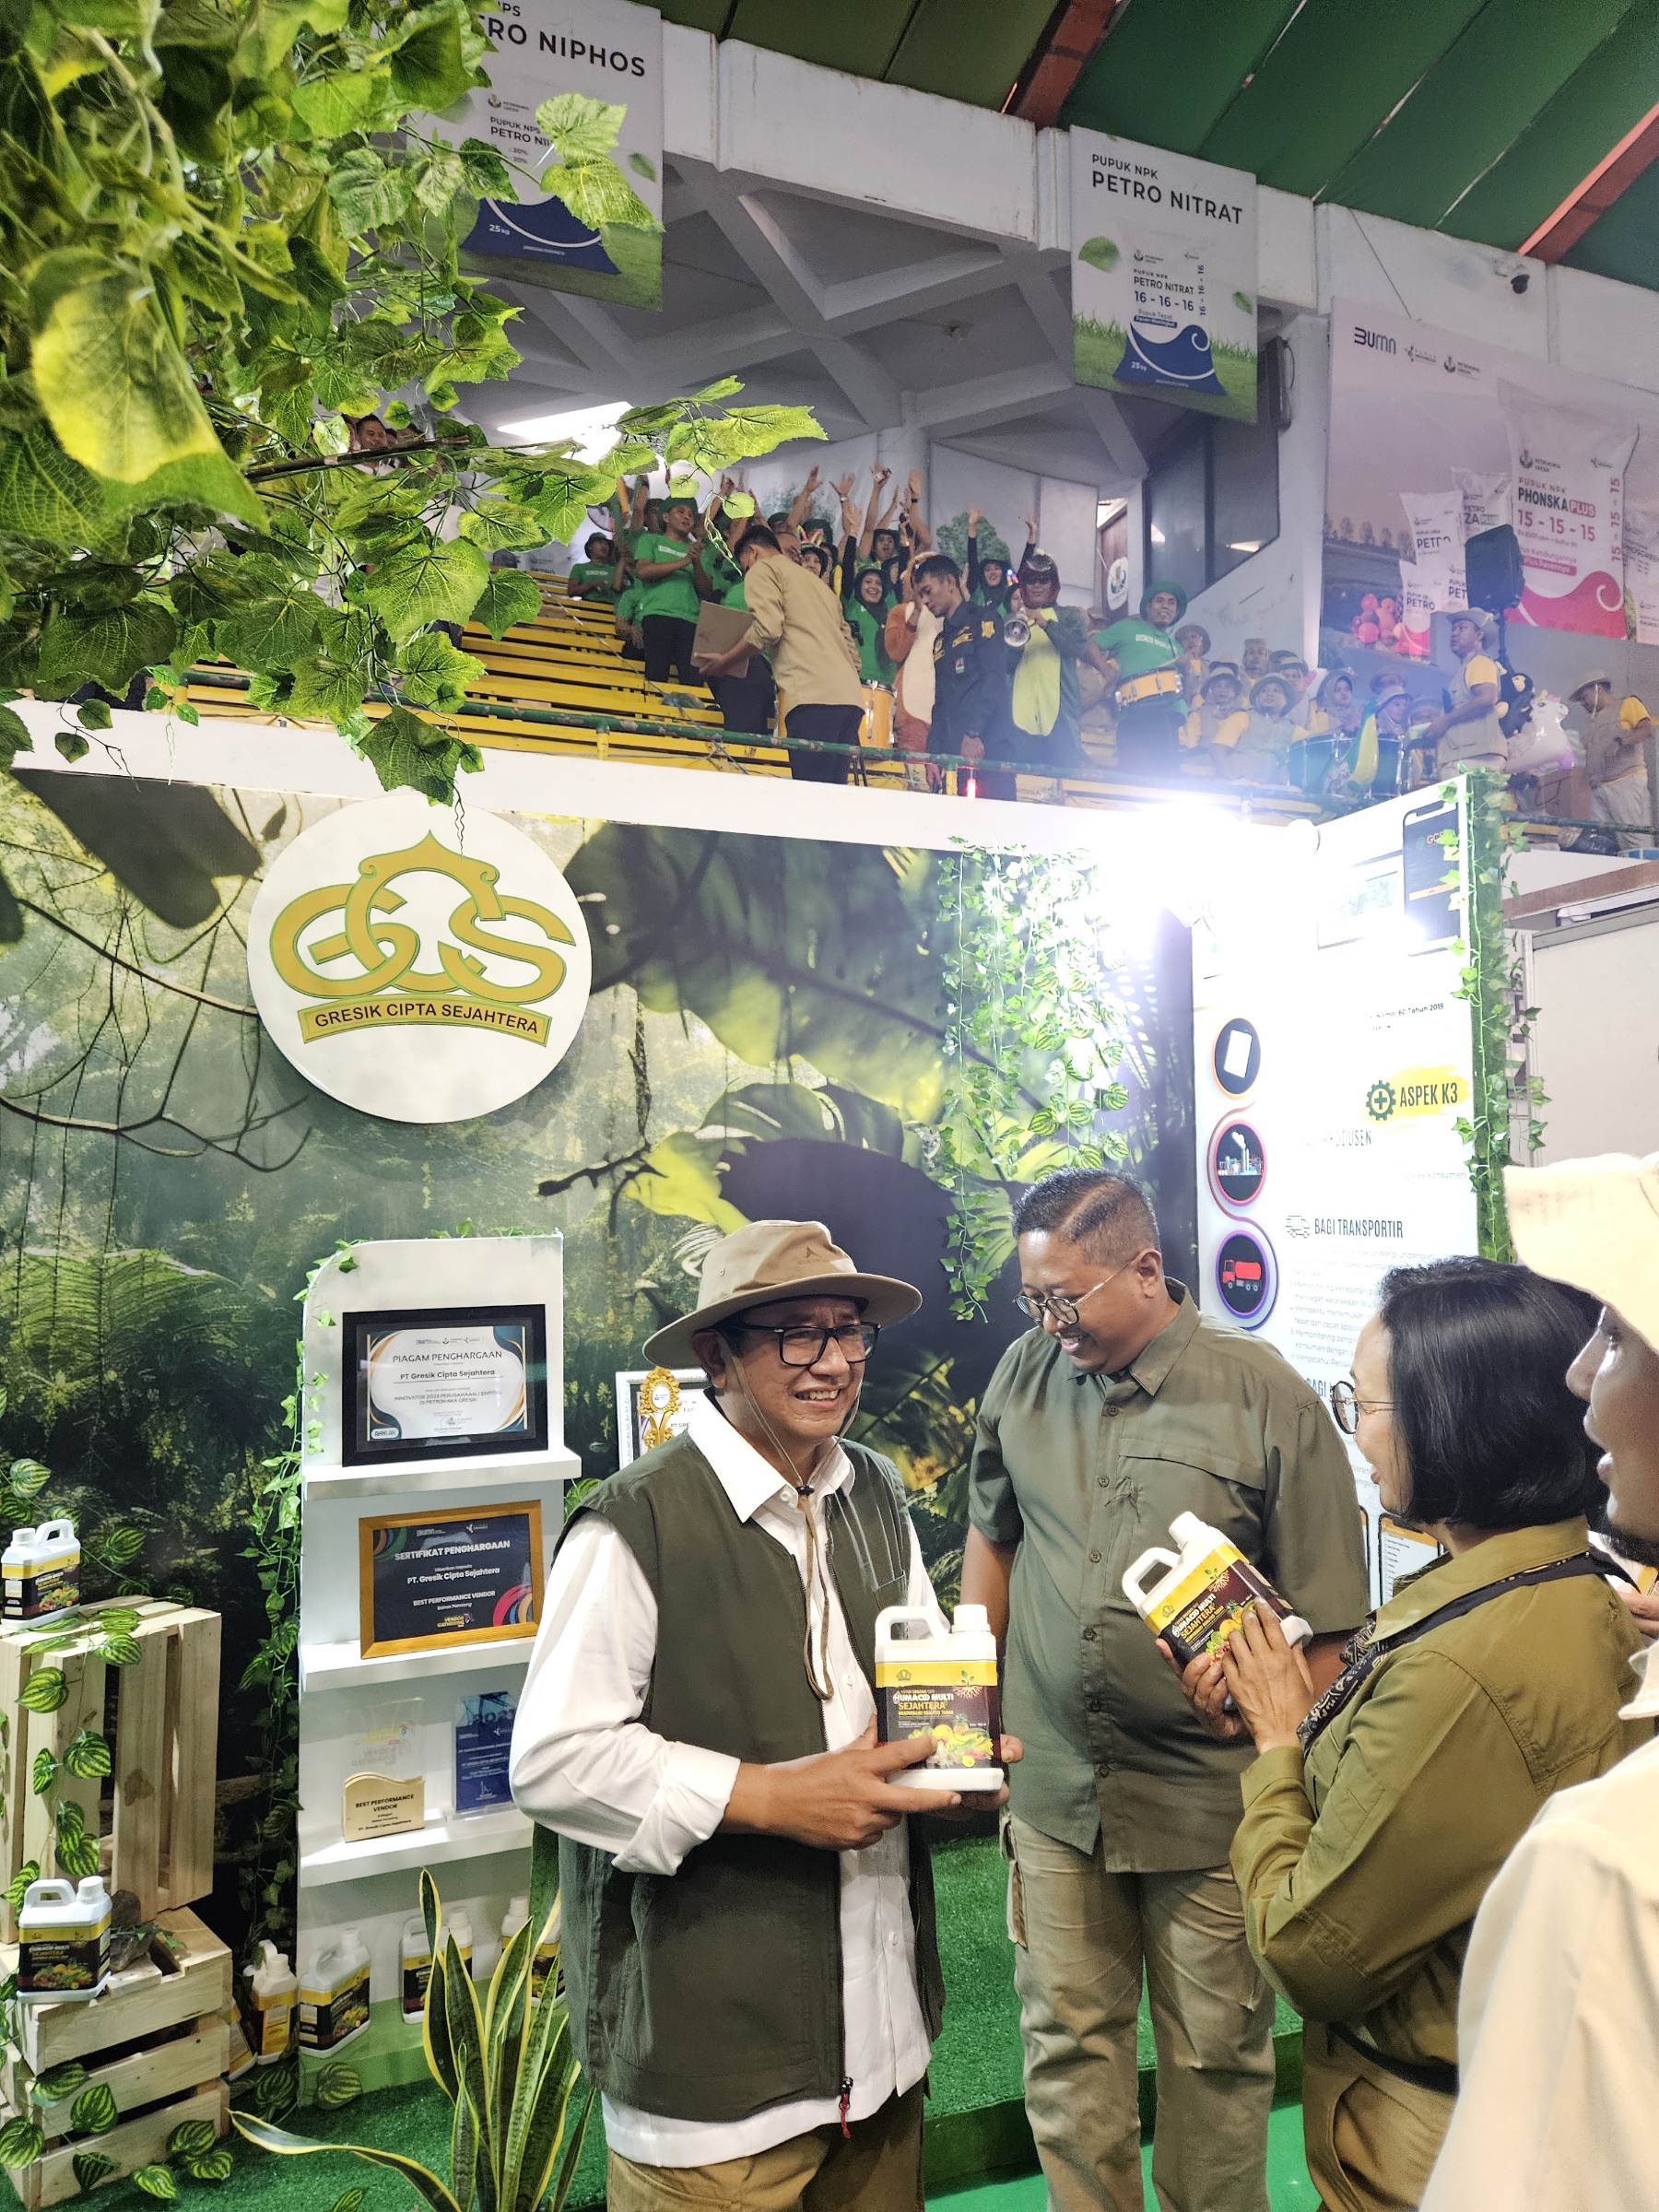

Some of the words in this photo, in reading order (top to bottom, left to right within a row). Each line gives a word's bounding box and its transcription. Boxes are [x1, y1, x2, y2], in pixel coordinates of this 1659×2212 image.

[499, 1, 521, 17] PS
[539, 30, 645, 77] NIPHOS
[489, 116, 522, 130] PUPUK
[490, 126, 531, 143] PETRO
[1092, 153, 1131, 172] PUPUK
[1135, 165, 1159, 180] NPK
[1092, 171, 1162, 204] PETRO
[1170, 190, 1243, 225] NITRAT
[1134, 276, 1163, 289] PETRO
[1165, 282, 1194, 296] NITRAT
[1135, 290, 1147, 303] 16
[1159, 295, 1171, 308] 16
[1182, 299, 1194, 312] 16
[1518, 477, 1547, 489] PUPUK
[1549, 484, 1567, 495] NPK
[1610, 477, 1620, 493] 15
[1518, 487, 1569, 512] PHONSKA
[1570, 500, 1595, 517] PLUS
[1465, 512, 1480, 525] ZA
[1518, 509, 1533, 527] 15
[1549, 516, 1565, 535] 15
[1581, 524, 1595, 542] 15
[1610, 512, 1620, 527] 15
[1611, 546, 1621, 561] 15
[1406, 598, 1435, 611] PETRO
[1407, 1005, 1429, 1015] Tahun
[1430, 1003, 1444, 1011] 2019
[314, 1004, 382, 1028] GRESIK
[386, 1002, 437, 1017] CIPTA
[441, 1004, 539, 1034] SEJAHTERA
[1400, 1084, 1439, 1107] ASPEK
[1441, 1082, 1458, 1104] K3
[1314, 1218, 1335, 1235] BAGI
[1338, 1218, 1404, 1238] TRANSPORTIR
[393, 1354, 429, 1363] PIAGAM
[431, 1350, 502, 1361] PENGHARGAAN
[459, 1369, 496, 1378] Sejahtera
[394, 1547, 443, 1560] SERTIFIKAT
[444, 1540, 511, 1555] PENGHARGAAN
[407, 1576, 419, 1584] PT.
[419, 1574, 443, 1583] Gresik
[443, 1571, 465, 1582] Cipta
[465, 1568, 500, 1579] Sejahtera
[428, 1594, 472, 1604] PERFORMANCE
[472, 1590, 496, 1599] VENDOR
[1198, 1593, 1217, 1612] MULTI
[1180, 1605, 1216, 1640] SEJAHTERA
[899, 1701, 946, 1710] SEJAHTERA
[371, 1794, 415, 1806] PERFORMANCE
[373, 1804, 398, 1812] VENDOR
